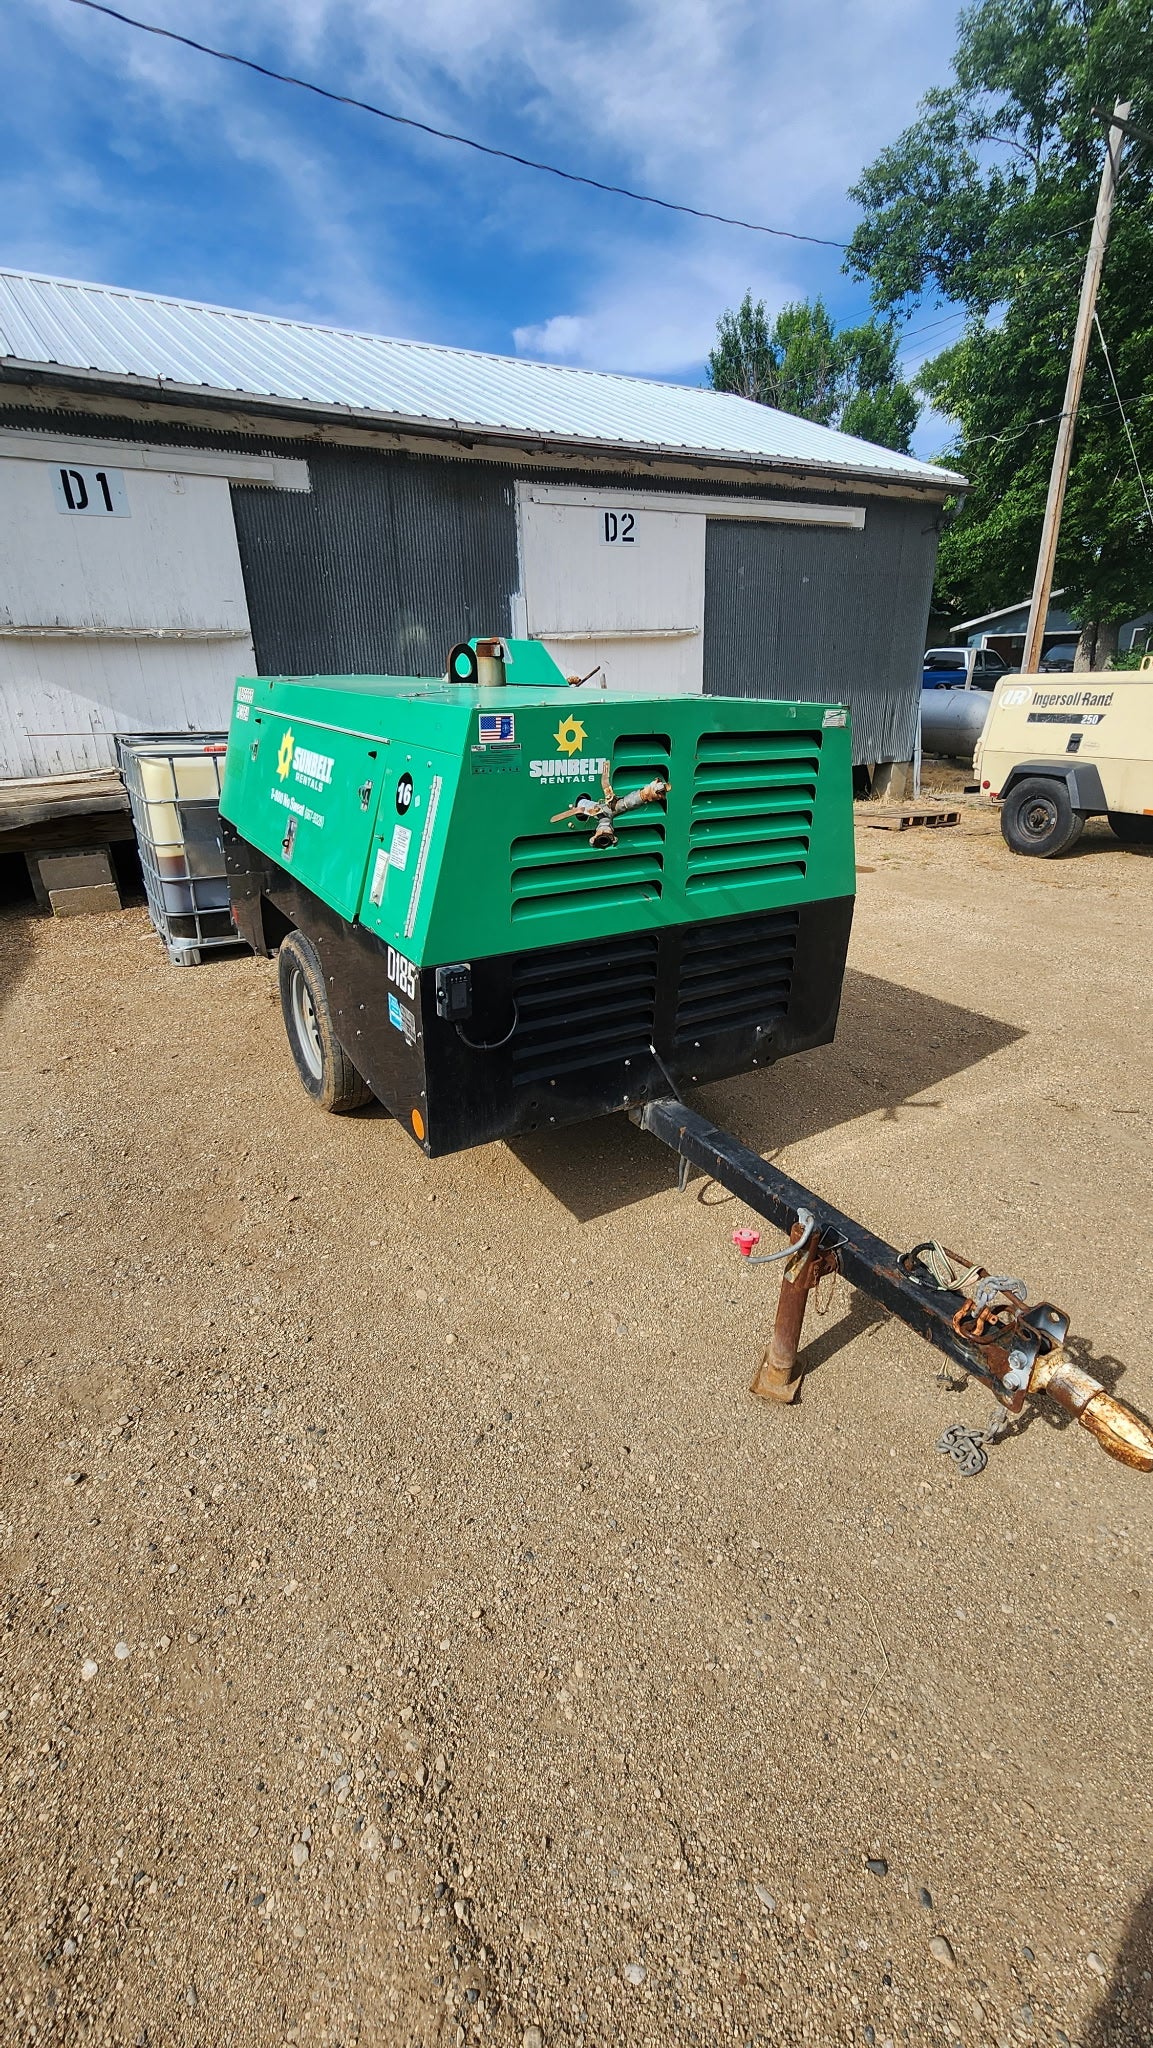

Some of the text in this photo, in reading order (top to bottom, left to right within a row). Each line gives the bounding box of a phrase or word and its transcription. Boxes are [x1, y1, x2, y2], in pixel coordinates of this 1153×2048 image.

[60, 469, 113, 512] D1
[604, 512, 635, 542] D2
[1081, 714, 1099, 725] 250
[292, 746, 335, 785] SUNBELT
[529, 757, 607, 778] SUNBELT
[295, 771, 324, 793] RENTALS
[540, 775, 595, 785] RENTALS
[397, 782, 412, 806] 16
[388, 945, 417, 1001] D185
